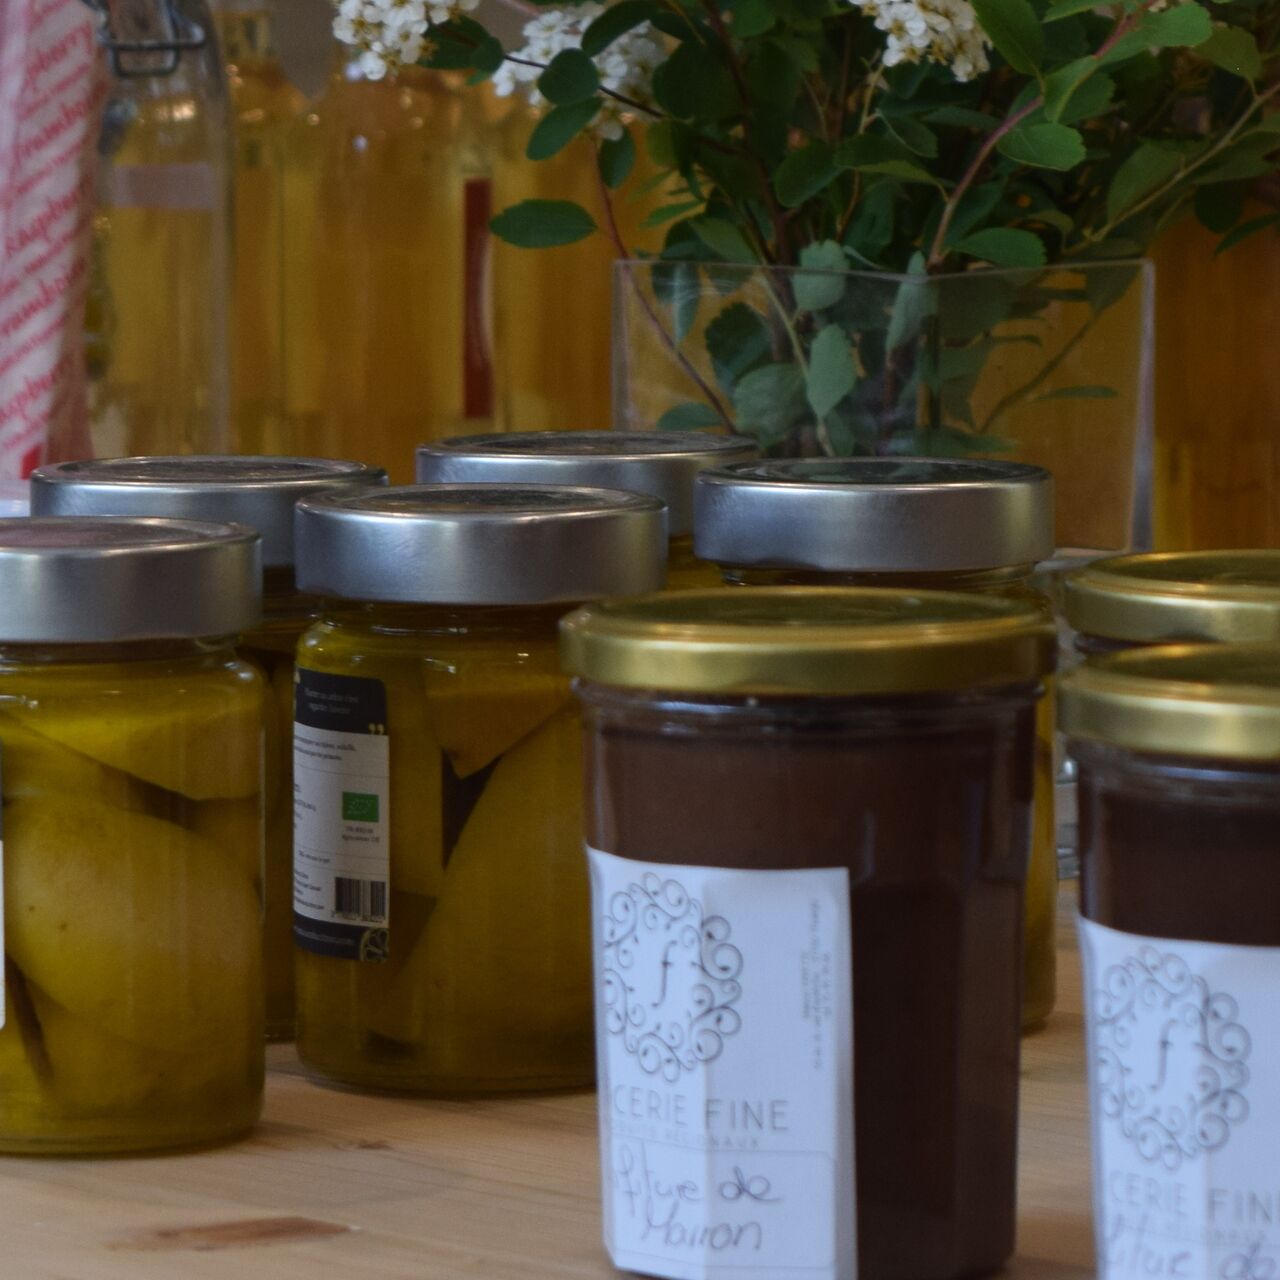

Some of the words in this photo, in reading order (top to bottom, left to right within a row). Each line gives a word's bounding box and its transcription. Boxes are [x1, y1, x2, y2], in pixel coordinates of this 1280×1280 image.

[613, 1083, 689, 1128] CERIE
[704, 1098, 790, 1133] FINE
[719, 1166, 783, 1204] de
